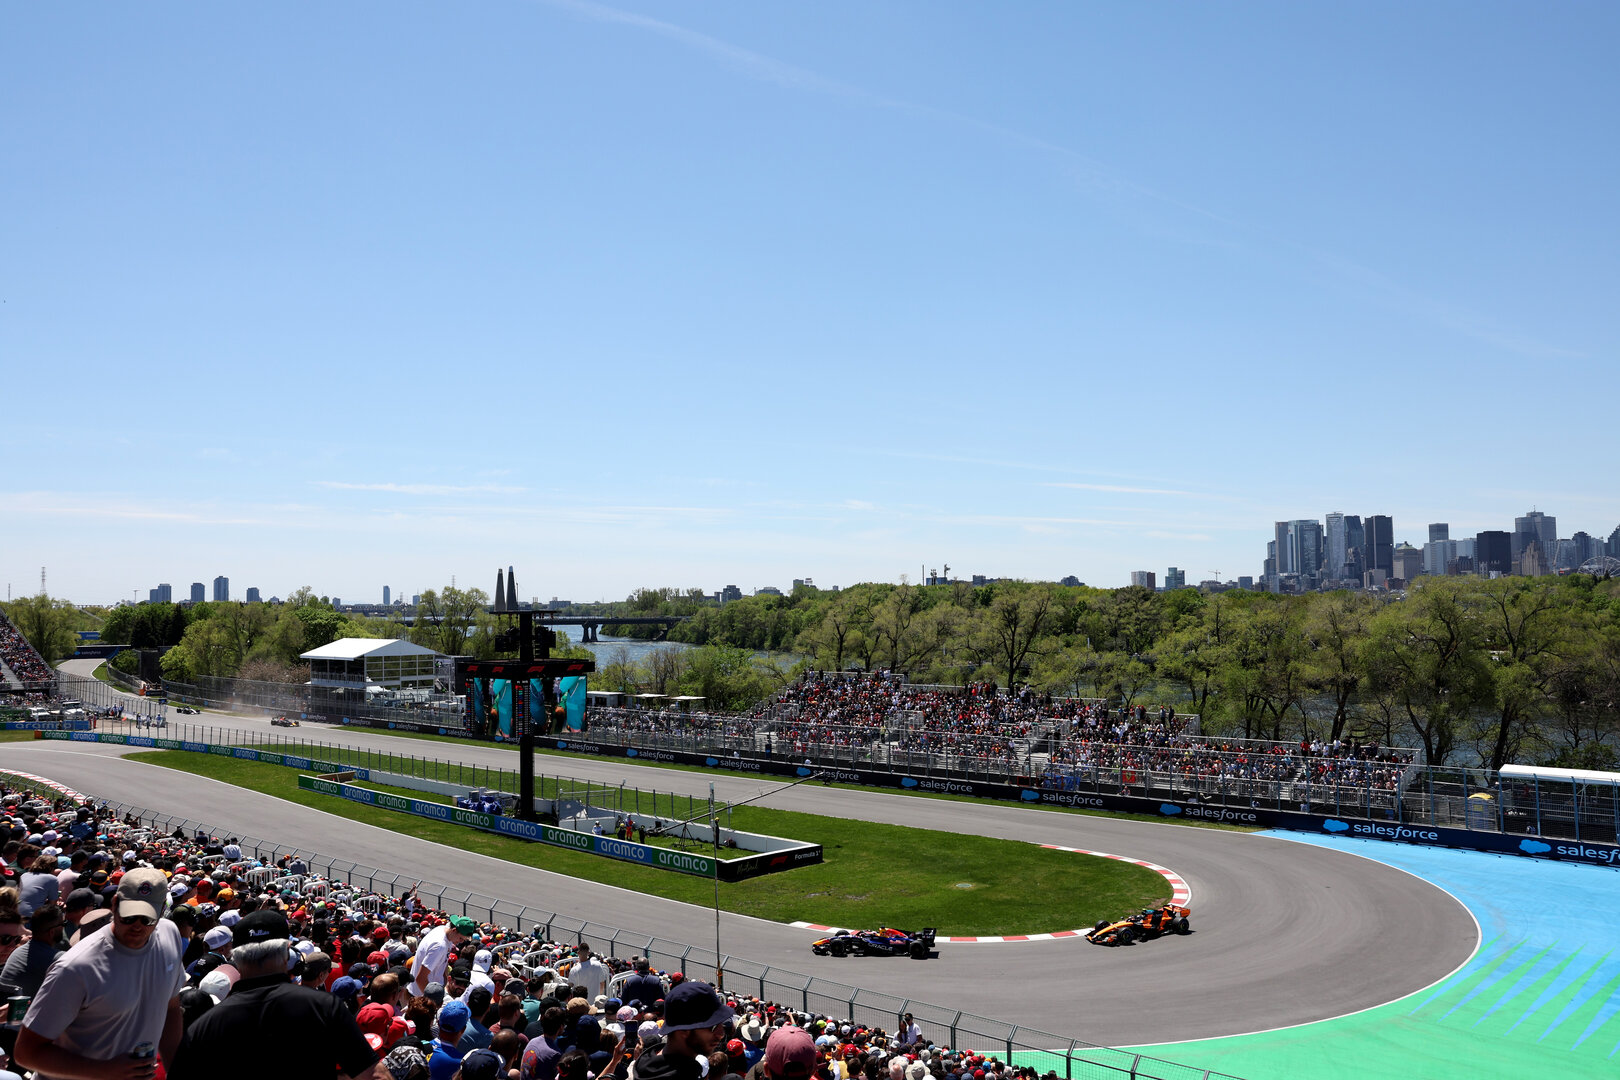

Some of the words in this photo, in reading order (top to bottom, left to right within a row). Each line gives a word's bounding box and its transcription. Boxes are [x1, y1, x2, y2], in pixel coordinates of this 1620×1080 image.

[102, 734, 124, 742] aramco
[130, 737, 152, 746] aramco
[157, 740, 178, 748] aramco
[184, 742, 205, 752] aramco
[210, 745, 230, 755] aramco
[568, 742, 600, 752] salesforce
[236, 749, 256, 760] aramco
[260, 753, 280, 764] aramco
[639, 750, 674, 760] salesforce
[286, 757, 308, 768] aramco
[312, 762, 336, 772] aramco
[720, 759, 760, 770] salesforce
[313, 780, 338, 794] aramco
[920, 780, 972, 792] salesforce
[344, 788, 370, 802] aramco
[1042, 792, 1104, 806] salesforce
[378, 794, 406, 809] aramco
[415, 802, 446, 817] aramco
[1185, 806, 1256, 822] salesforce
[456, 810, 490, 826] aramco
[500, 818, 537, 836] aramco
[1353, 822, 1438, 840] salesforce
[548, 826, 588, 848] aramco
[600, 840, 645, 860] aramco
[794, 852, 815, 860] Formula
[1556, 844, 1620, 862] salesf
[658, 852, 708, 872] aramco
